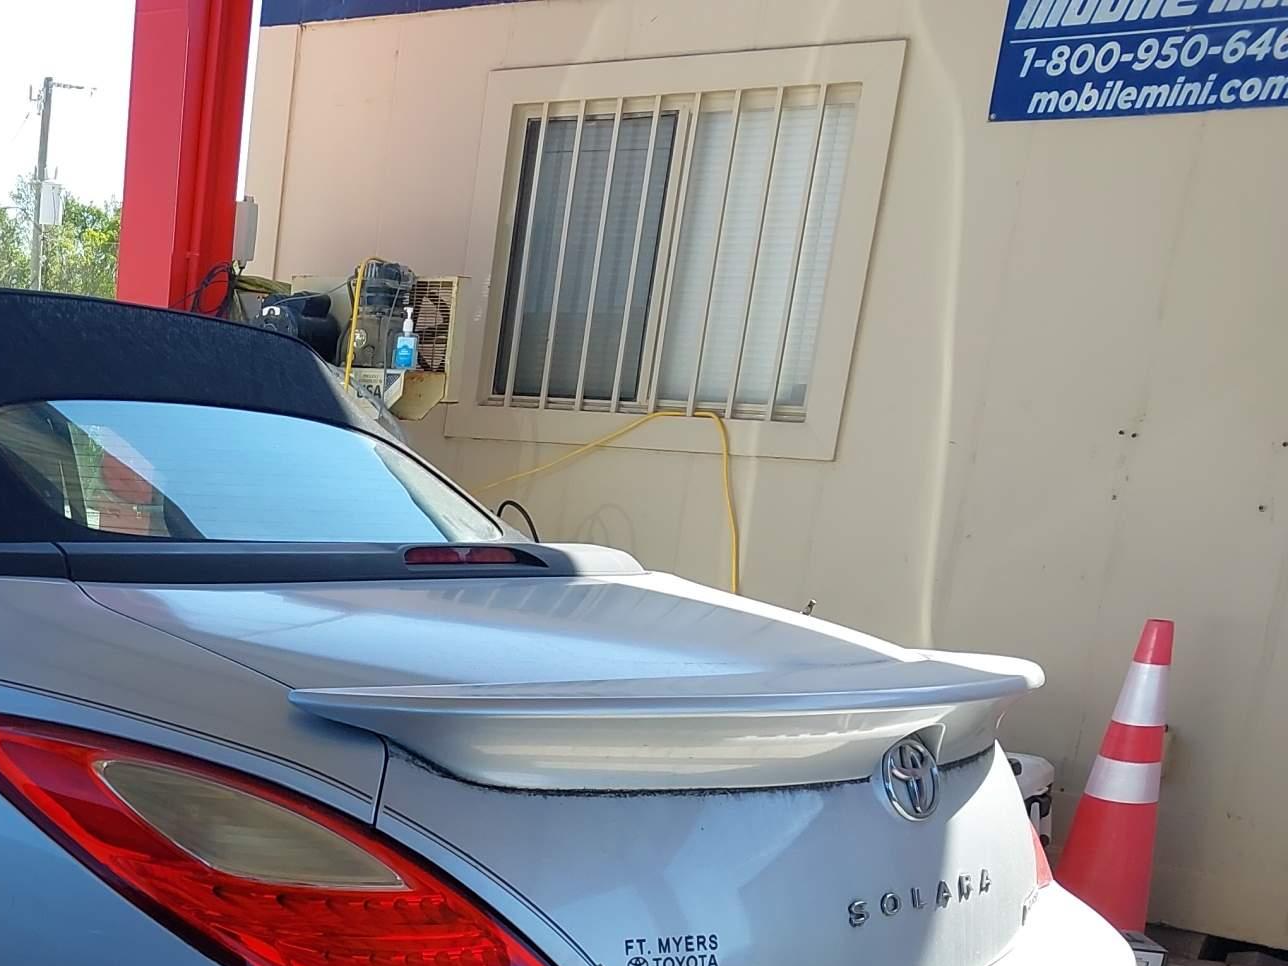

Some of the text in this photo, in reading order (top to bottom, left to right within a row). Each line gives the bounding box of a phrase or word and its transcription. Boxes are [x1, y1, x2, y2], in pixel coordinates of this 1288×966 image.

[1027, 73, 1288, 114] mobilemini.com
[847, 868, 993, 928] SOLARA
[624, 934, 719, 956] FT. MYERS
